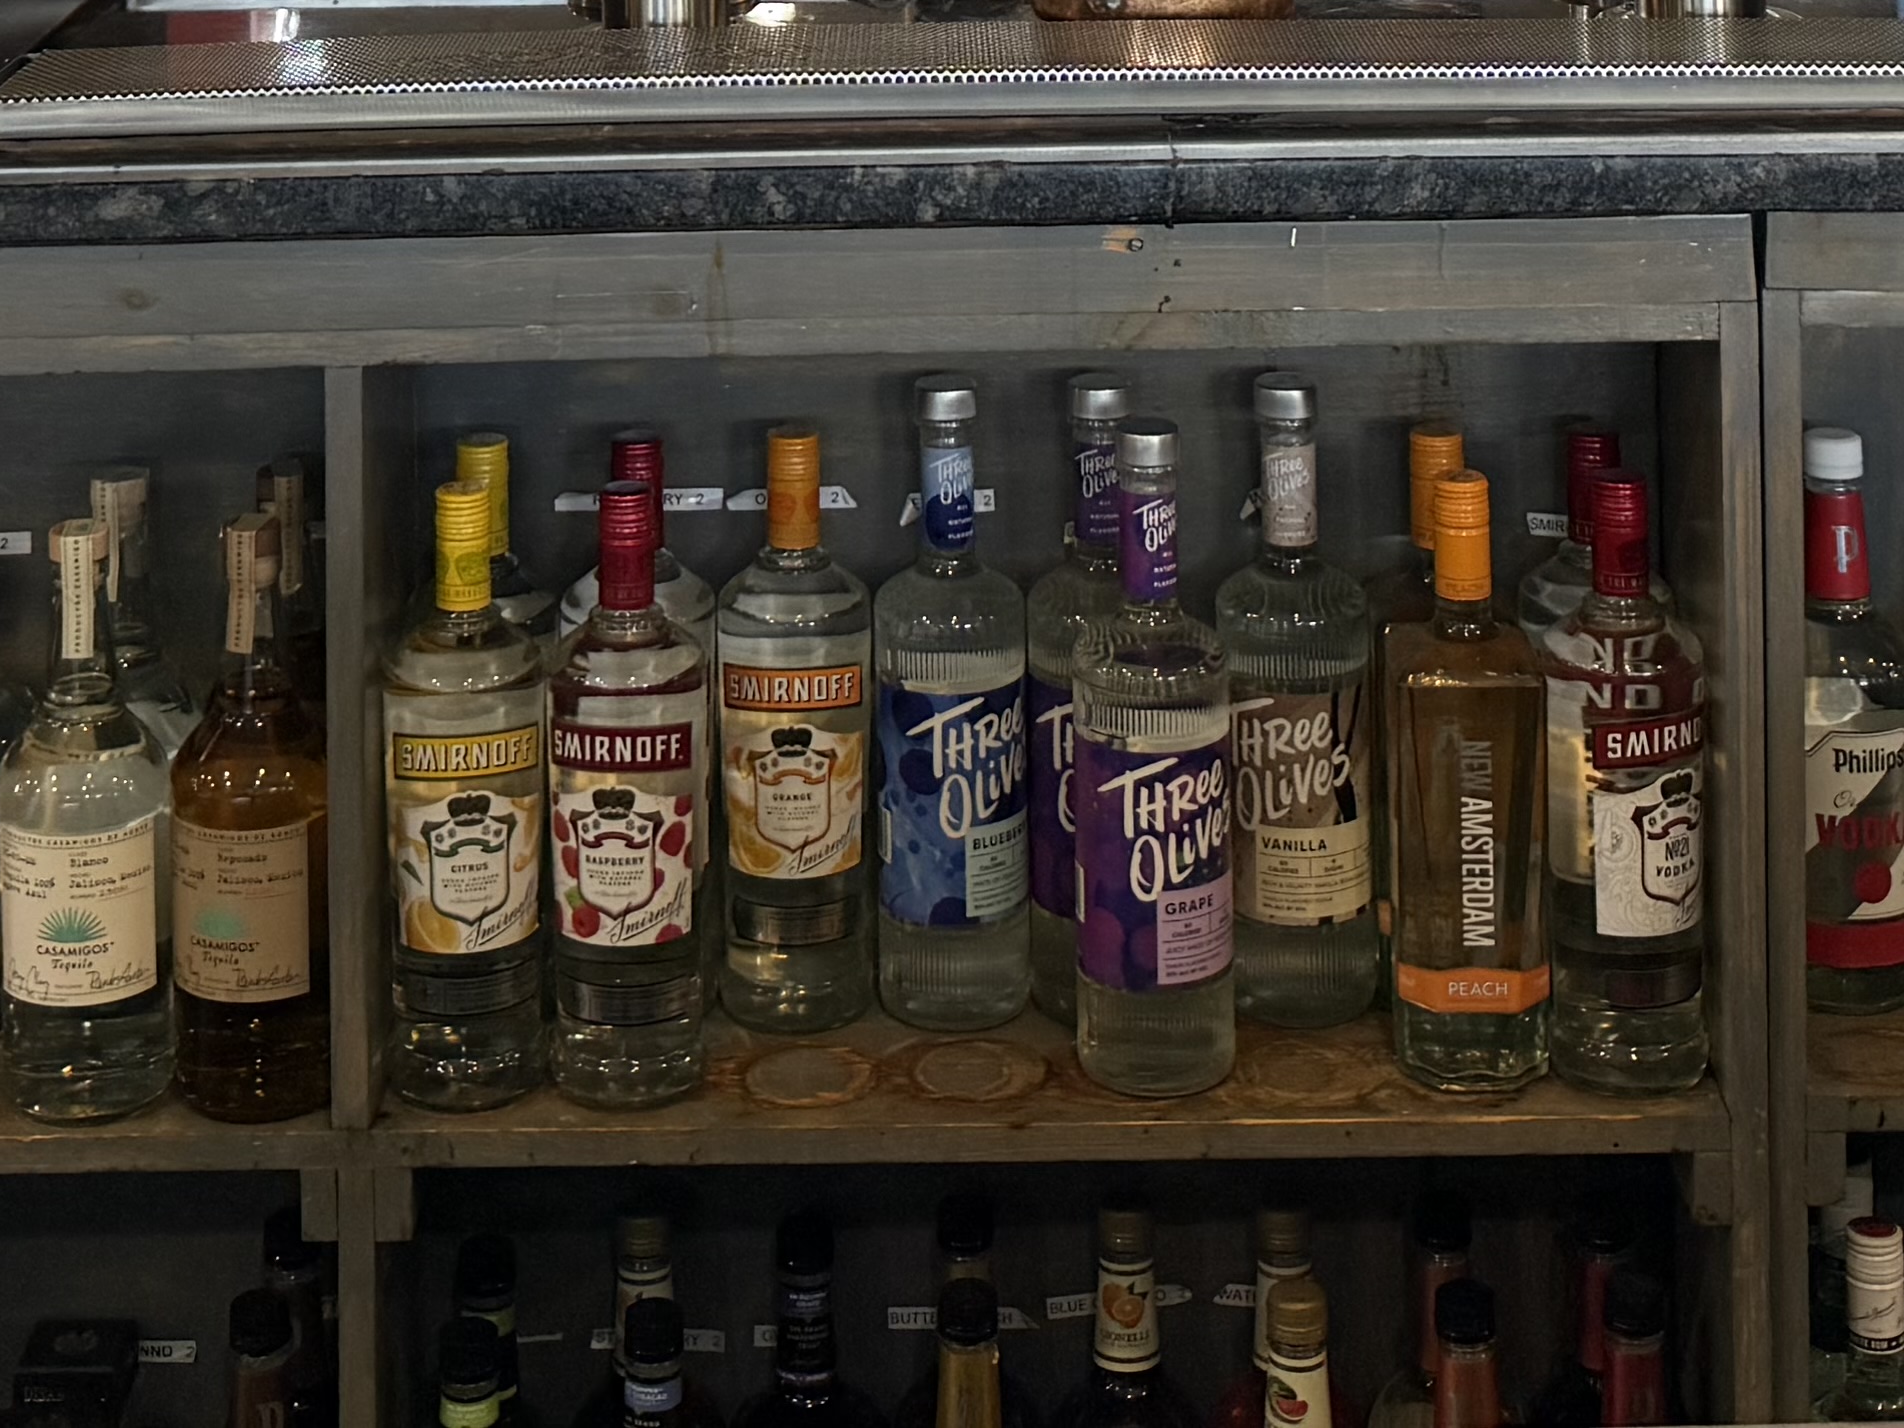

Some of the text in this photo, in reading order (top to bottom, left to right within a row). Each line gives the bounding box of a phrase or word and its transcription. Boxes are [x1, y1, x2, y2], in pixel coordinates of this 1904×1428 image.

[0, 537, 9, 551] 2
[729, 672, 856, 703] SMIRNOFF
[401, 736, 532, 771] SMIRNOFF
[554, 728, 684, 763] SMIRNOFF
[1261, 836, 1328, 853] VANILLA
[450, 862, 490, 874] CITRUS
[585, 854, 645, 868] RASPBERRY
[1461, 796, 1496, 946] AMSTERDAM
[1165, 894, 1215, 917] GRAPE
[36, 941, 109, 958] CASAMIGOS
[1448, 980, 1508, 997] PEACH
